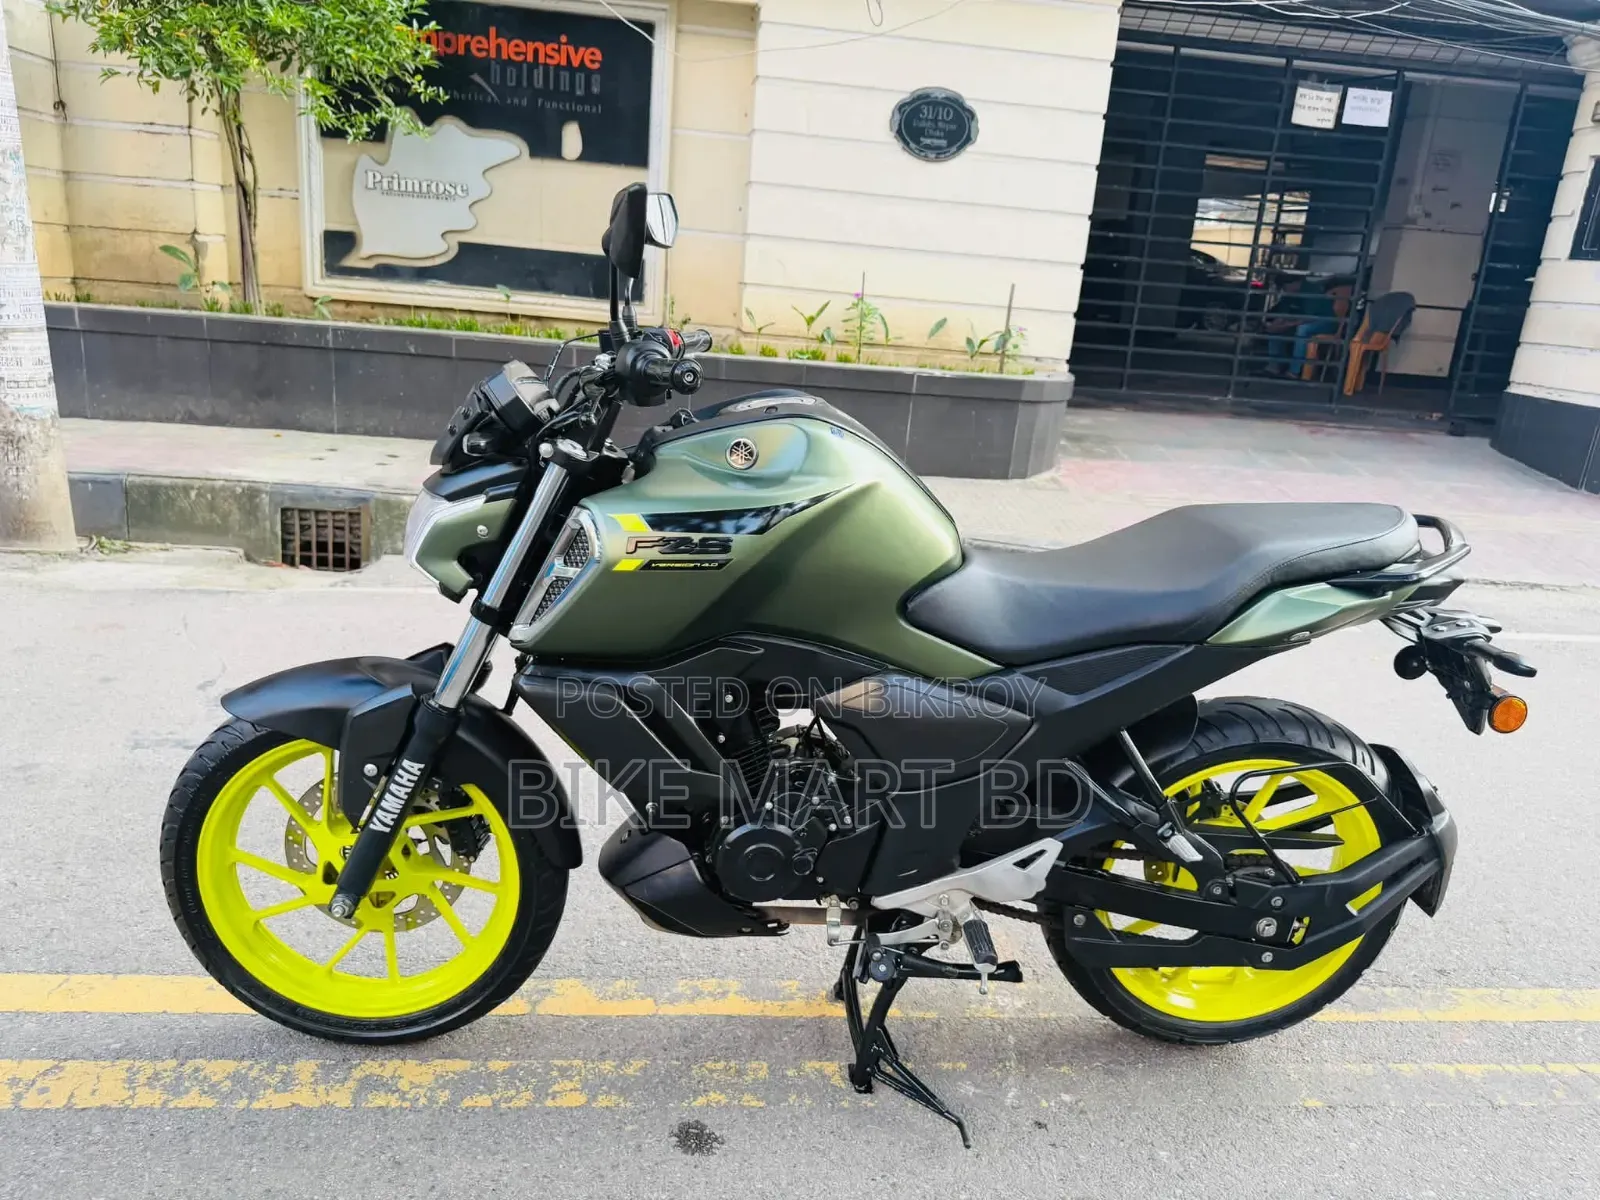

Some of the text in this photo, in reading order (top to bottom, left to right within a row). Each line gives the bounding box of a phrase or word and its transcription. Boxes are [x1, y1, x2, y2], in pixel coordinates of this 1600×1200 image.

[490, 60, 601, 96] holdings
[919, 104, 954, 121] 31/10
[364, 169, 469, 198] Primrose
[368, 758, 426, 833] YAMAHA
